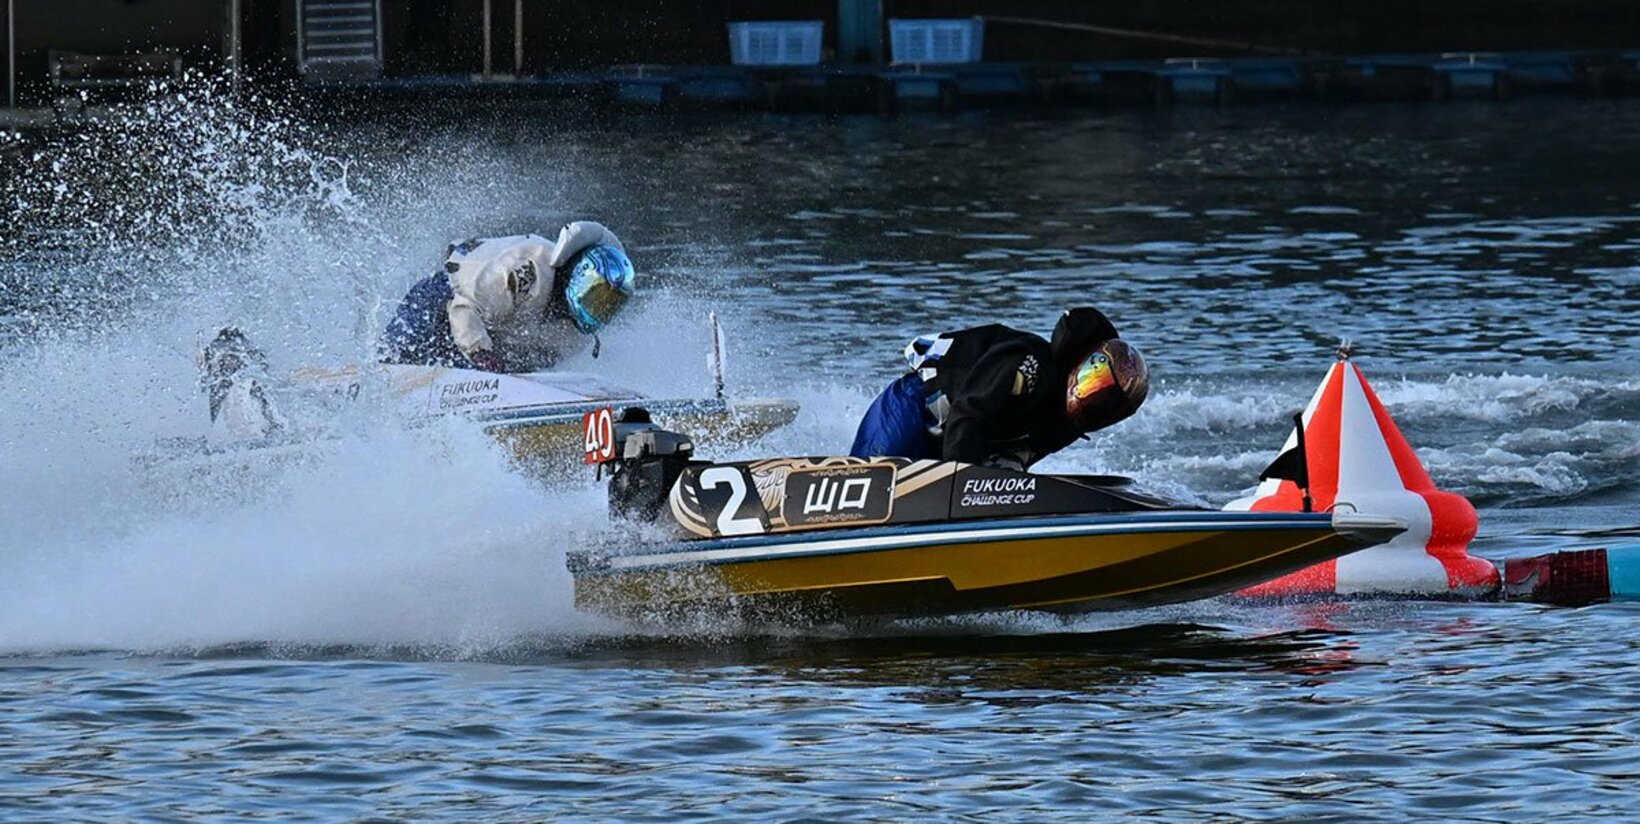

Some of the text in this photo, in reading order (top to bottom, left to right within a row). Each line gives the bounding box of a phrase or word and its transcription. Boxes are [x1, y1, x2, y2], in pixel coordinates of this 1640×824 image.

[441, 378, 500, 396] FUKUOKA
[585, 409, 612, 460] 40
[803, 477, 872, 514] 山口
[963, 477, 1036, 493] FUKUOKA
[700, 466, 765, 536] 2
[961, 494, 1035, 507] CHALLENGE CUP
